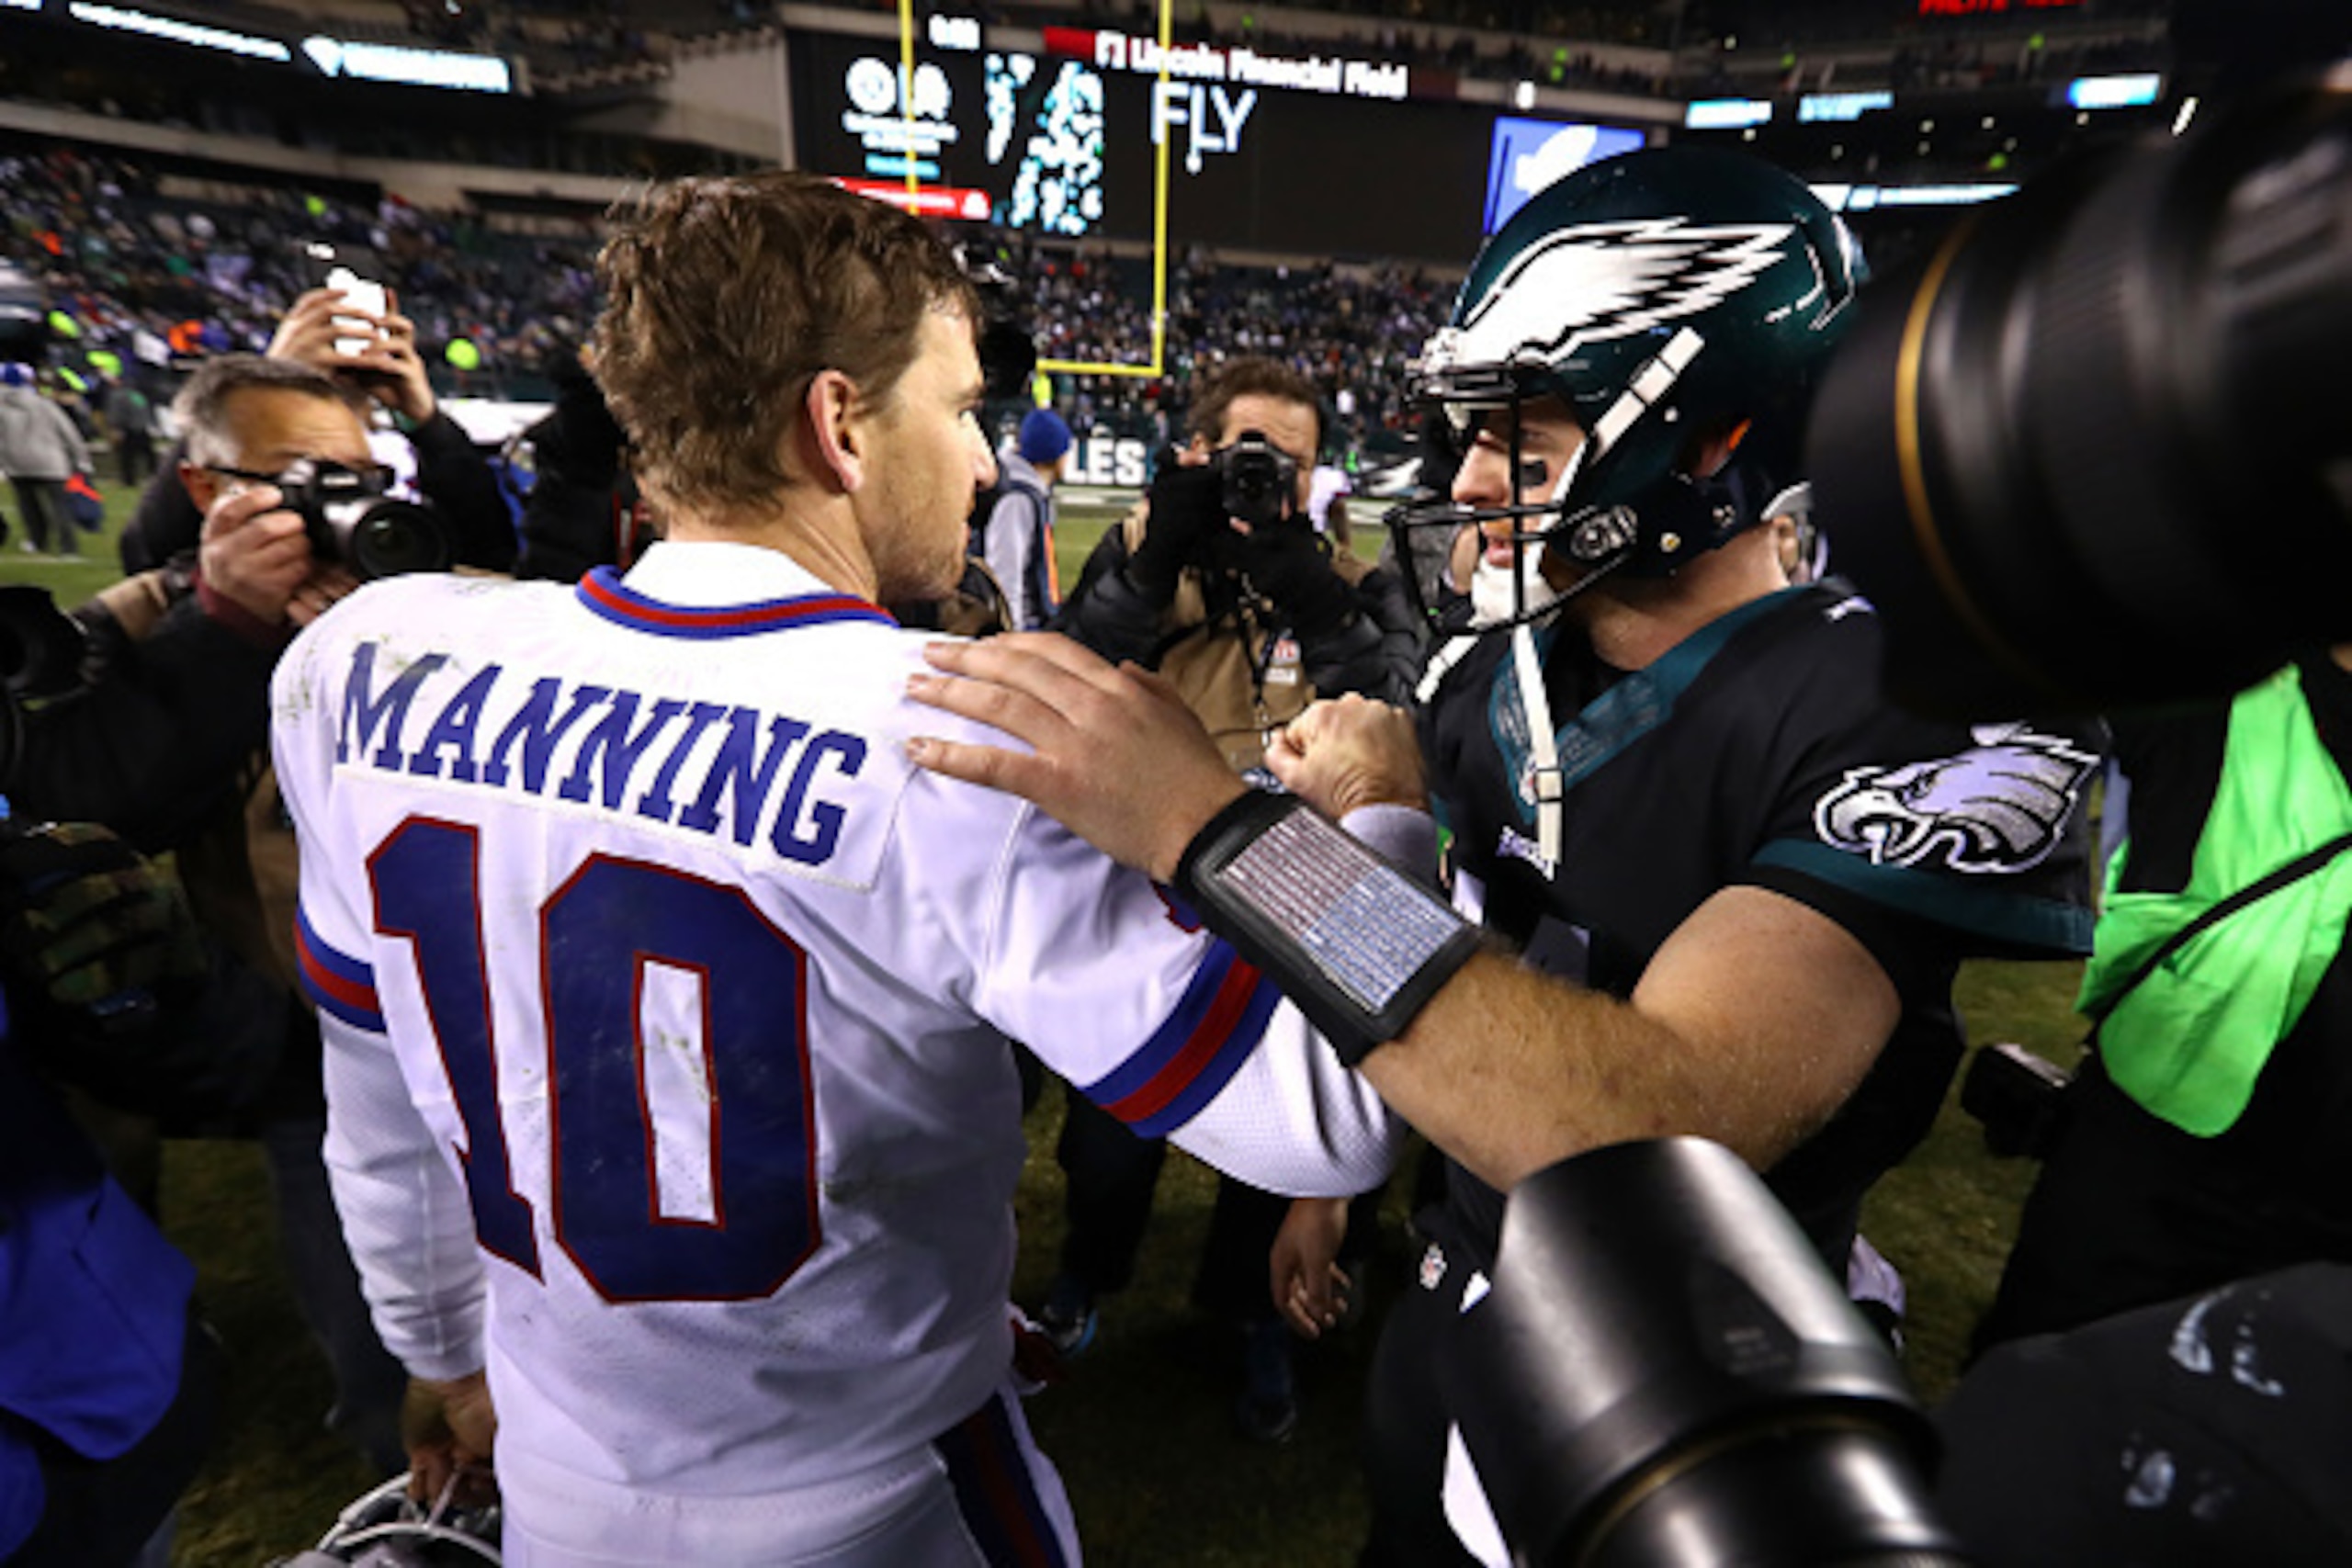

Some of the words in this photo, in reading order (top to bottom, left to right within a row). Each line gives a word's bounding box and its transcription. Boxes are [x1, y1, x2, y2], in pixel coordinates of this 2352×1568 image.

[1151, 81, 1257, 153] FLY
[335, 641, 867, 866] MANNING
[366, 814, 822, 1304] 10
